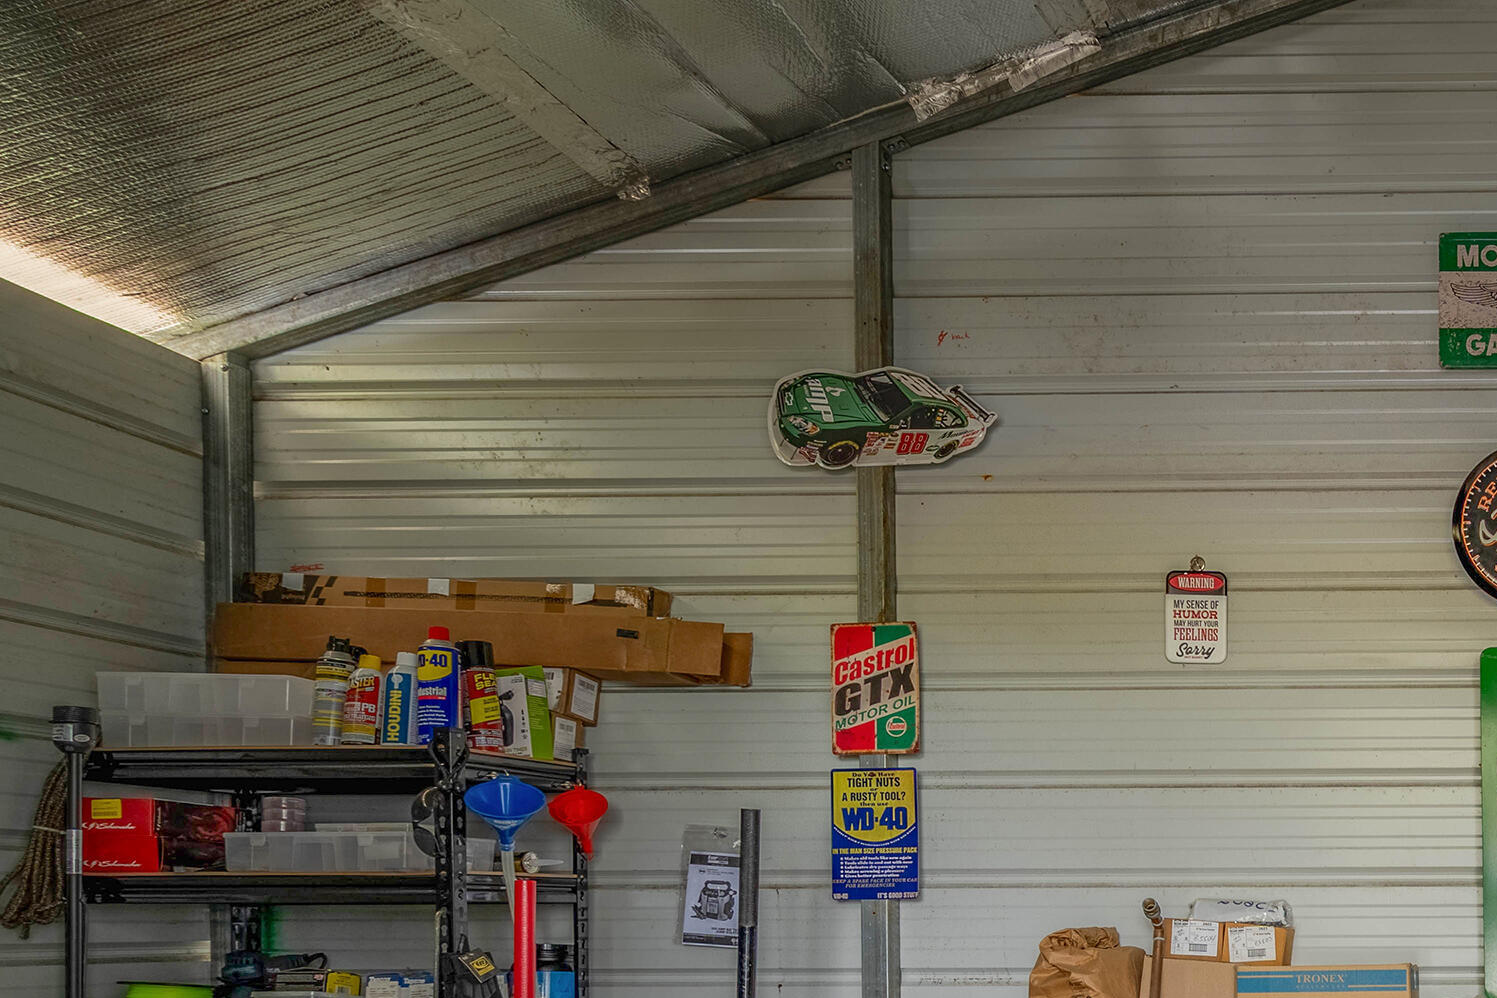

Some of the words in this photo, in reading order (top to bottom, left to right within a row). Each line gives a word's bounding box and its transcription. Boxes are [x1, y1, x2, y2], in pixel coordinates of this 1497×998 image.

[897, 432, 929, 455] 88
[1177, 576, 1215, 589] WARNING
[1173, 599, 1184, 609] MY
[1186, 600, 1208, 609] SENSE
[1210, 600, 1219, 609] OF
[1173, 610, 1218, 619] HUMOR
[1173, 627, 1218, 641] FEELINGS
[1176, 642, 1215, 659] Sorry
[418, 654, 448, 668] D-40
[834, 637, 915, 686] Castrol
[474, 672, 496, 683] FLE
[475, 680, 497, 690] SEA
[835, 662, 915, 716] GTX
[386, 690, 402, 741] HOUDINI
[835, 703, 889, 730] MOTOR
[893, 695, 916, 709] OIL
[847, 778, 873, 788] TIGHT
[876, 777, 900, 787] NUTS
[842, 793, 848, 801] A
[850, 792, 877, 801] RUSTY
[880, 791, 906, 801] TOOL?
[1295, 974, 1345, 984] TRONEX
